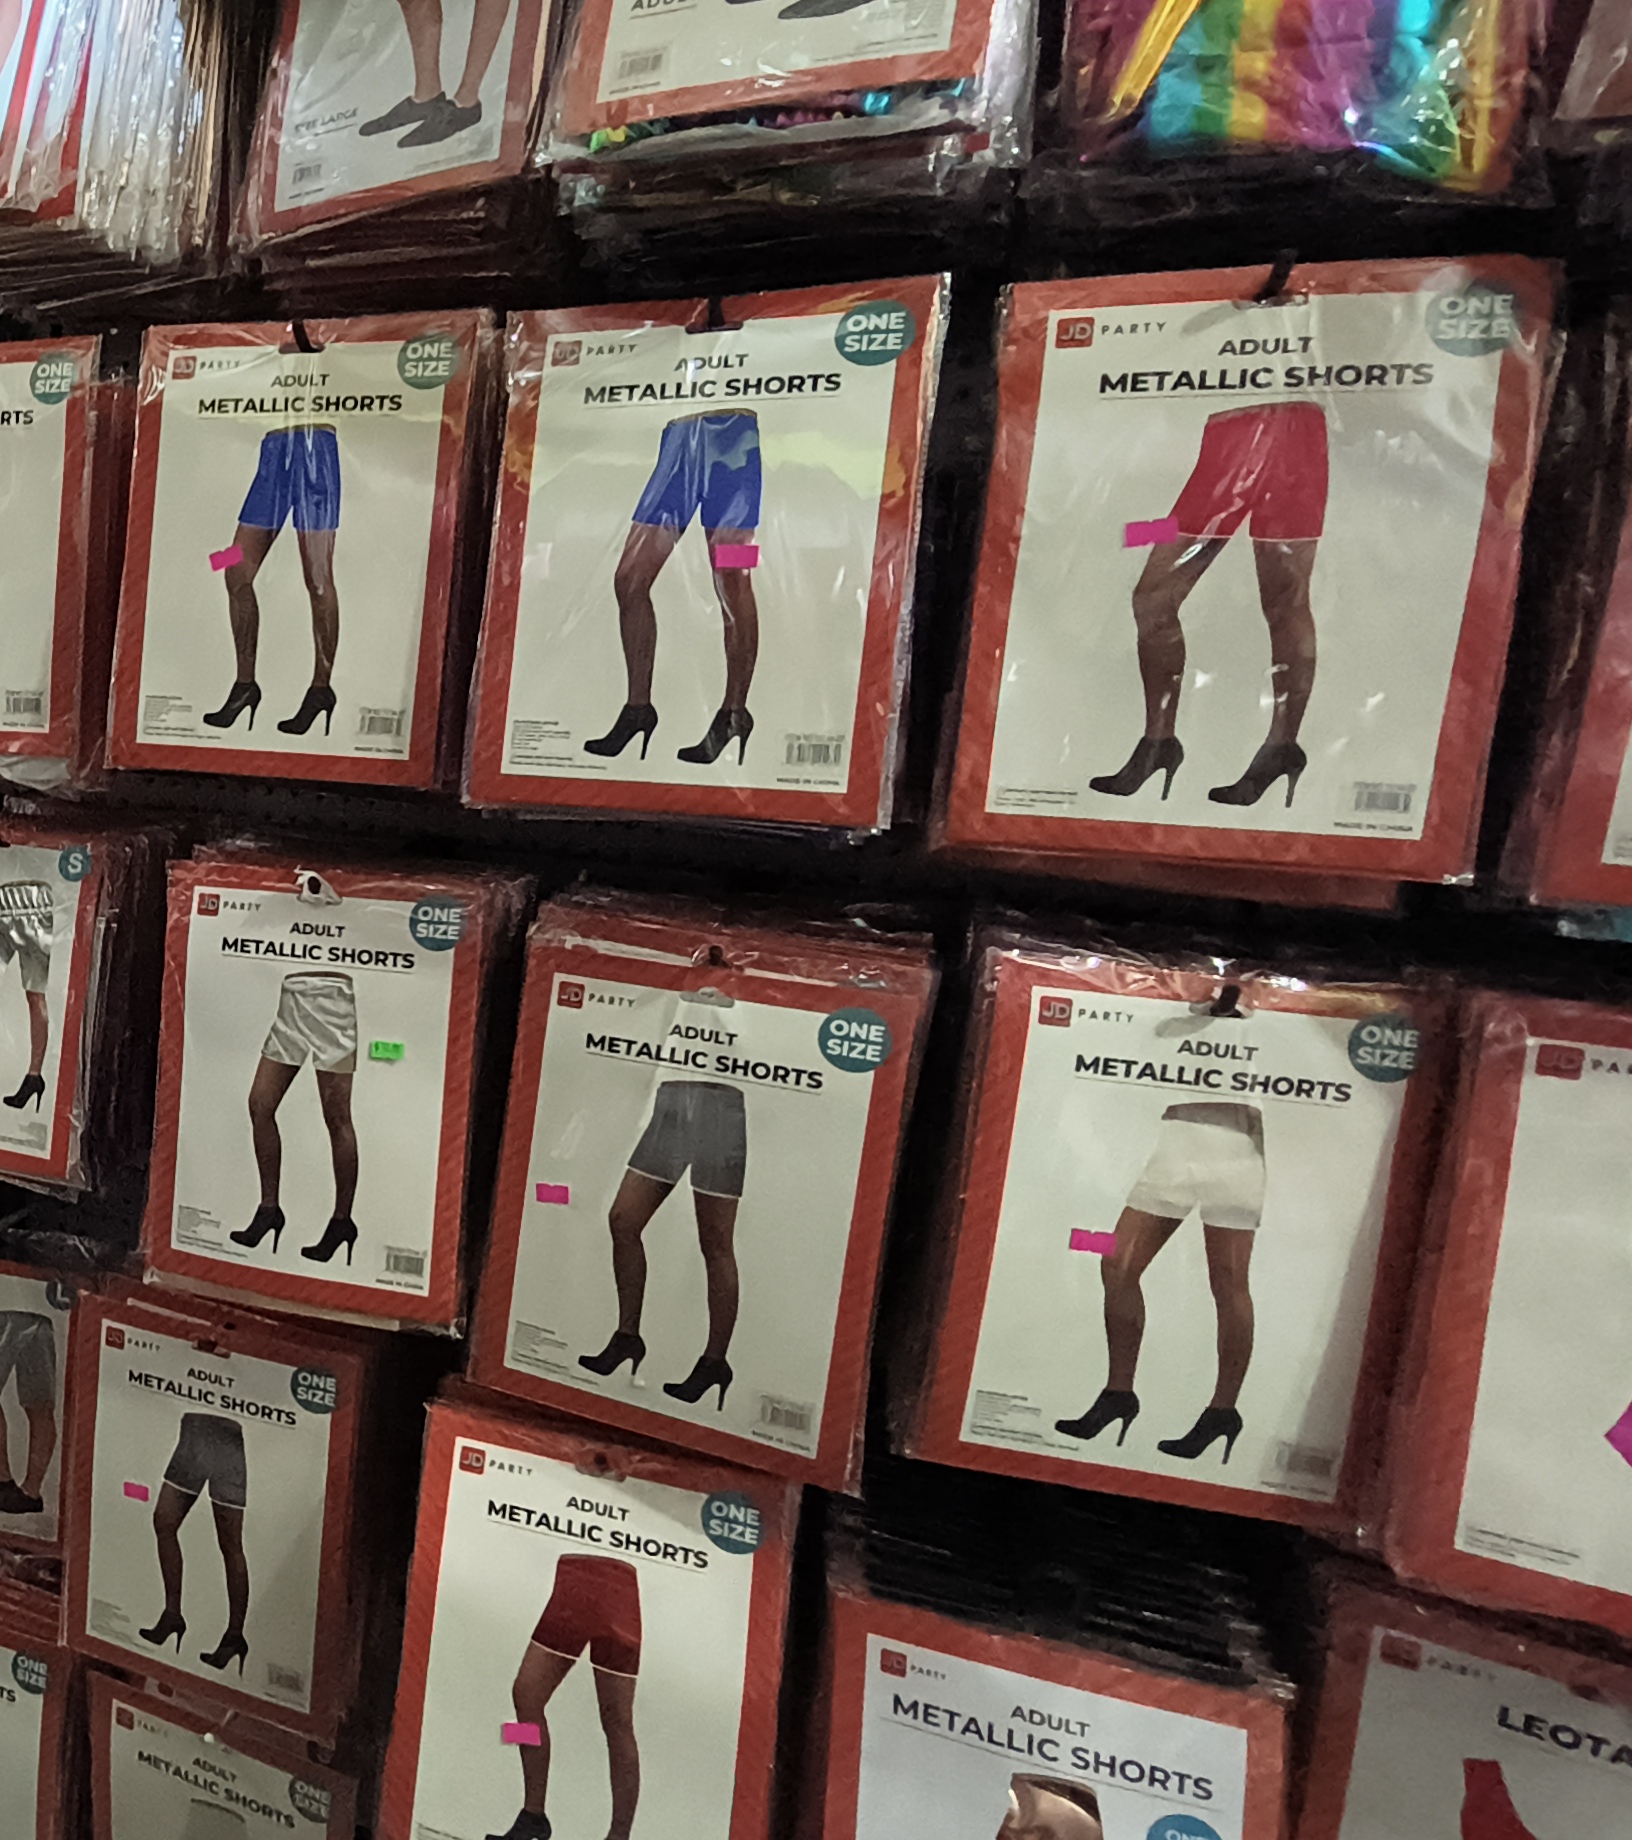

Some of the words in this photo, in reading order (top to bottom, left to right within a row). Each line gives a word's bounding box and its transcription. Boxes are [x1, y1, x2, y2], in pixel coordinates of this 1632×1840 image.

[1439, 294, 1514, 315] ONE
[845, 312, 906, 331] ONE
[1101, 322, 1167, 335] PARTY
[1437, 317, 1511, 339] SIZE
[405, 342, 452, 358] ONE
[843, 332, 903, 352] SIZE
[1218, 336, 1313, 356] ADULT
[36, 362, 73, 377] ONE
[404, 360, 450, 377] SIZE
[674, 354, 748, 372] ADULT
[34, 378, 71, 394] SIZE
[271, 374, 330, 388] ADULT
[583, 379, 716, 404] METALLIC
[724, 373, 841, 398] SHORTS
[1099, 367, 1275, 393] METALLIC
[1284, 363, 1434, 388] SHORTS
[198, 397, 305, 415] METALLIC
[310, 395, 403, 413] SHORTS
[68, 853, 82, 873] S
[418, 906, 462, 923] ONE
[289, 922, 346, 938] ADULT
[416, 922, 460, 940] SIZE
[221, 937, 322, 961] METALLIC
[328, 945, 416, 969] SHORTS
[588, 993, 636, 1008] PARTY
[1078, 1008, 1135, 1025] PARTY
[669, 1023, 738, 1047] ADULT
[829, 1019, 886, 1042] ONE
[1360, 1025, 1419, 1049] ONE
[826, 1038, 882, 1062] SIZE
[1177, 1040, 1259, 1062] ADULT
[1356, 1046, 1415, 1070] SIZE
[586, 1033, 709, 1070] METALLIC
[715, 1055, 824, 1090] SHORTS
[1074, 1054, 1223, 1091] METALLIC
[1231, 1071, 1353, 1103] SHORTS
[187, 1367, 236, 1389] ADULT
[297, 1371, 337, 1393] ONE
[128, 1369, 216, 1405] METALLIC
[220, 1395, 297, 1426] SHORTS
[296, 1387, 336, 1408] SIZE
[566, 1496, 630, 1522] ADULT
[711, 1501, 760, 1526] ONE
[487, 1499, 604, 1543] METALLIC
[609, 1530, 709, 1569] SHORTS
[709, 1520, 759, 1546] SIZE
[17, 1656, 48, 1675] ONE
[910, 1664, 947, 1681] PARTY
[16, 1669, 47, 1689] SIZE
[1009, 1705, 1091, 1738] ADULT
[892, 1692, 1061, 1763] METALLIC
[1071, 1746, 1214, 1802] SHORTS
[192, 1757, 238, 1783] ADULT
[137, 1750, 220, 1795] METALLIC
[224, 1787, 296, 1829] SHORTS
